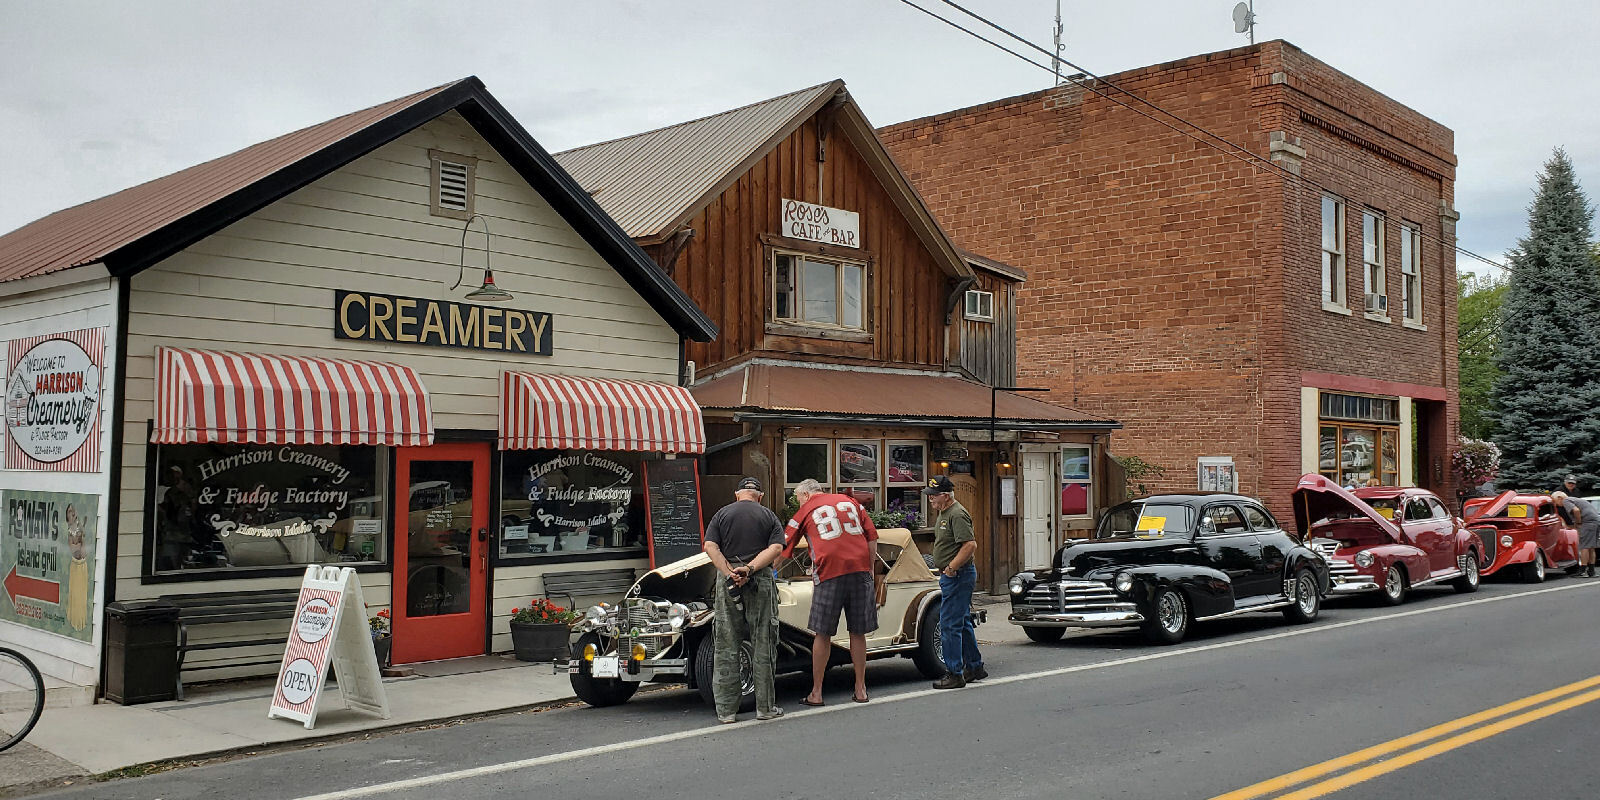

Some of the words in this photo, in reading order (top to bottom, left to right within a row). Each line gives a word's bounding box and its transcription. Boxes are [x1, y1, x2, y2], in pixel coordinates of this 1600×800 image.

[785, 200, 830, 225] Rose's
[791, 221, 822, 240] CAFE
[831, 228, 855, 246] BAR
[340, 293, 549, 353] CREAMERY
[25, 355, 57, 373] WELCOME
[58, 355, 66, 369] TO
[36, 371, 84, 395] HARRISON
[27, 392, 86, 434] Creamery
[198, 448, 273, 481] Harrison
[278, 446, 350, 485] Creamery
[528, 454, 580, 482] Harrison
[583, 453, 634, 484] Creamery
[198, 486, 220, 504] &
[224, 484, 279, 512] Fudge
[284, 487, 349, 511] Factory
[528, 485, 545, 501] &
[546, 484, 585, 507] Fudge
[588, 486, 632, 506] Factory
[236, 523, 282, 538] Harrison
[284, 521, 313, 537] Idaho
[554, 515, 586, 528] Harrison
[587, 514, 607, 527] Idaho
[812, 501, 865, 540] 83
[17, 542, 40, 569] island
[42, 546, 57, 577] grill
[306, 605, 328, 615] HARRISON
[284, 669, 316, 692] OPEN
